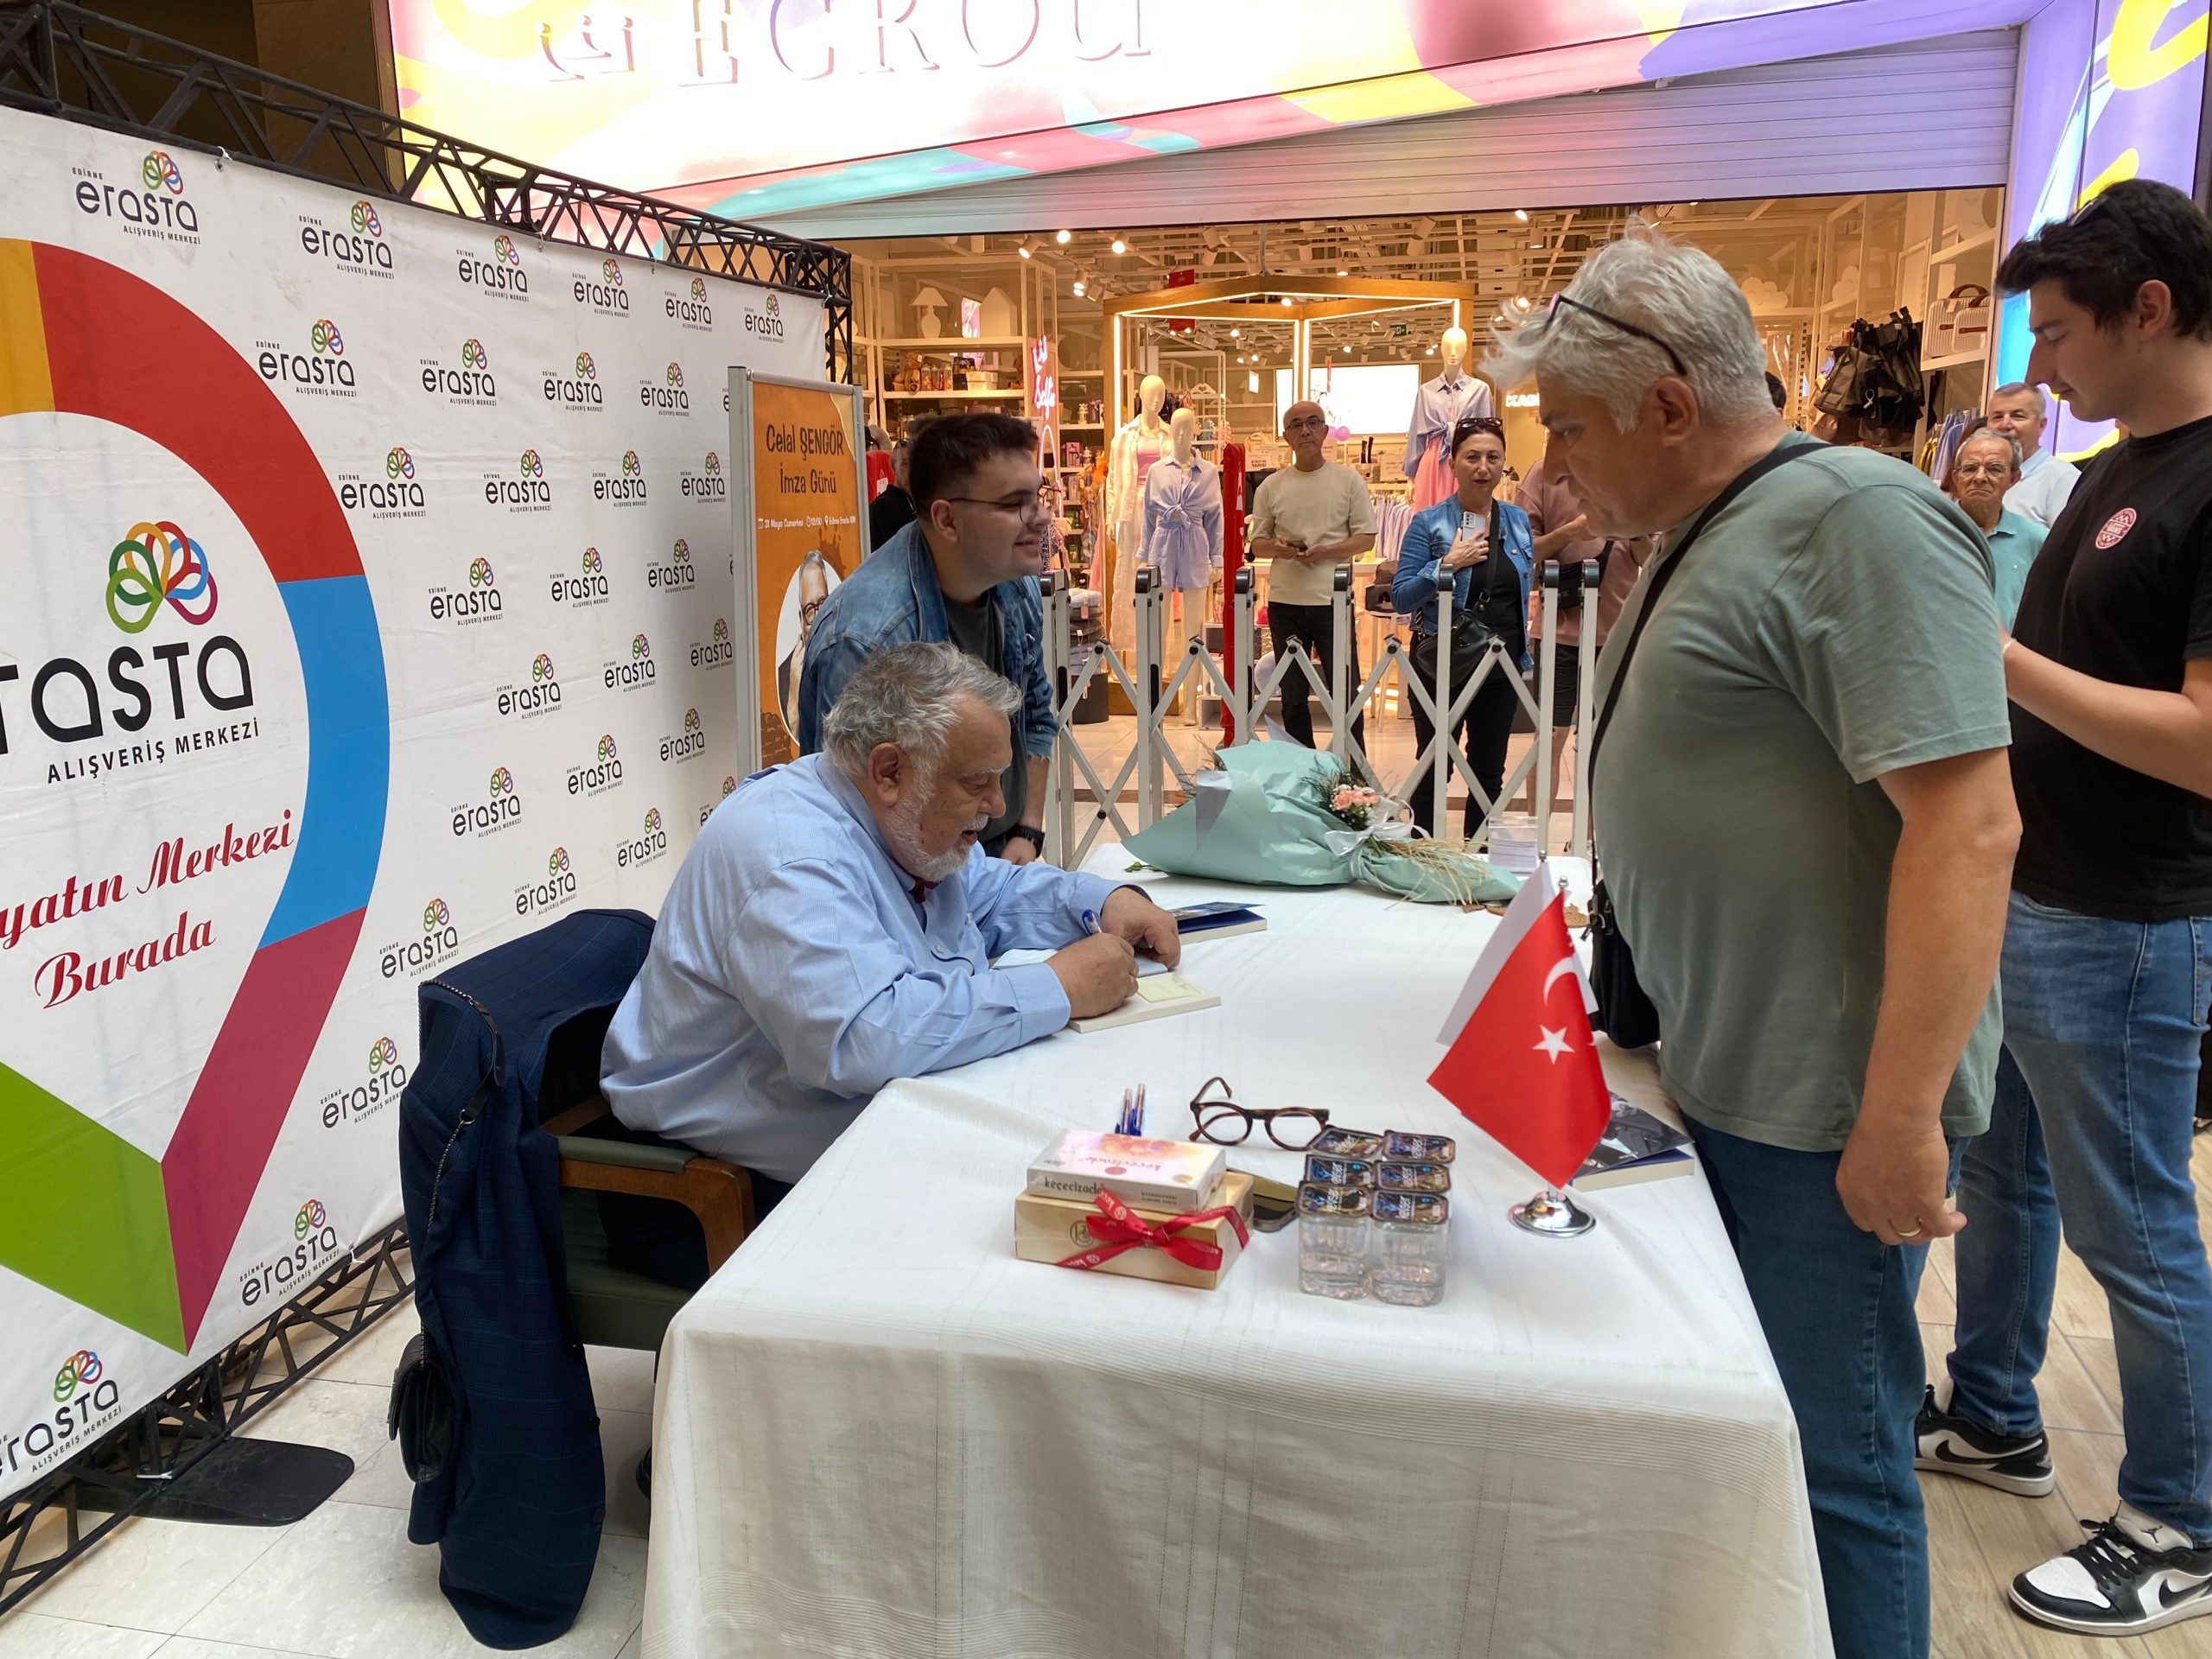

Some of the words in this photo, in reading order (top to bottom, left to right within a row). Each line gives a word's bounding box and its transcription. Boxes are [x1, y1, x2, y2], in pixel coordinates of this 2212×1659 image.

[73, 168, 103, 180] EDİRNE
[299, 215, 321, 226] EDİRNE
[124, 226, 163, 240] ALIŞVERİŞ
[168, 232, 200, 245] MERKEZİ
[337, 264, 366, 276] ALIŞVERİŞ
[370, 270, 394, 279] MERKEZİ
[256, 340, 280, 349] EDİRNE
[296, 387, 327, 396] ALIŞVERİŞ
[766, 423, 796, 453] Celal
[800, 424, 844, 461] ŞENGÖR
[780, 463, 806, 493] İmza
[810, 468, 837, 493] Günü
[0, 635, 253, 754] rasta
[47, 740, 166, 784] ALIŞVERİŞ
[175, 716, 259, 755] MERKEZİ
[0, 875, 128, 950] yatın
[136, 809, 294, 894] Merkezi
[35, 911, 216, 1009] Burada
[321, 1088, 341, 1105] EDİRNE
[355, 1103, 382, 1123] ALIŞVERİŞ
[240, 1261, 264, 1282] EDİRNE
[279, 1269, 310, 1297] ALIŞVERİŞ
[314, 1249, 339, 1272] MERKEZİ
[0, 1380, 119, 1477] rasta
